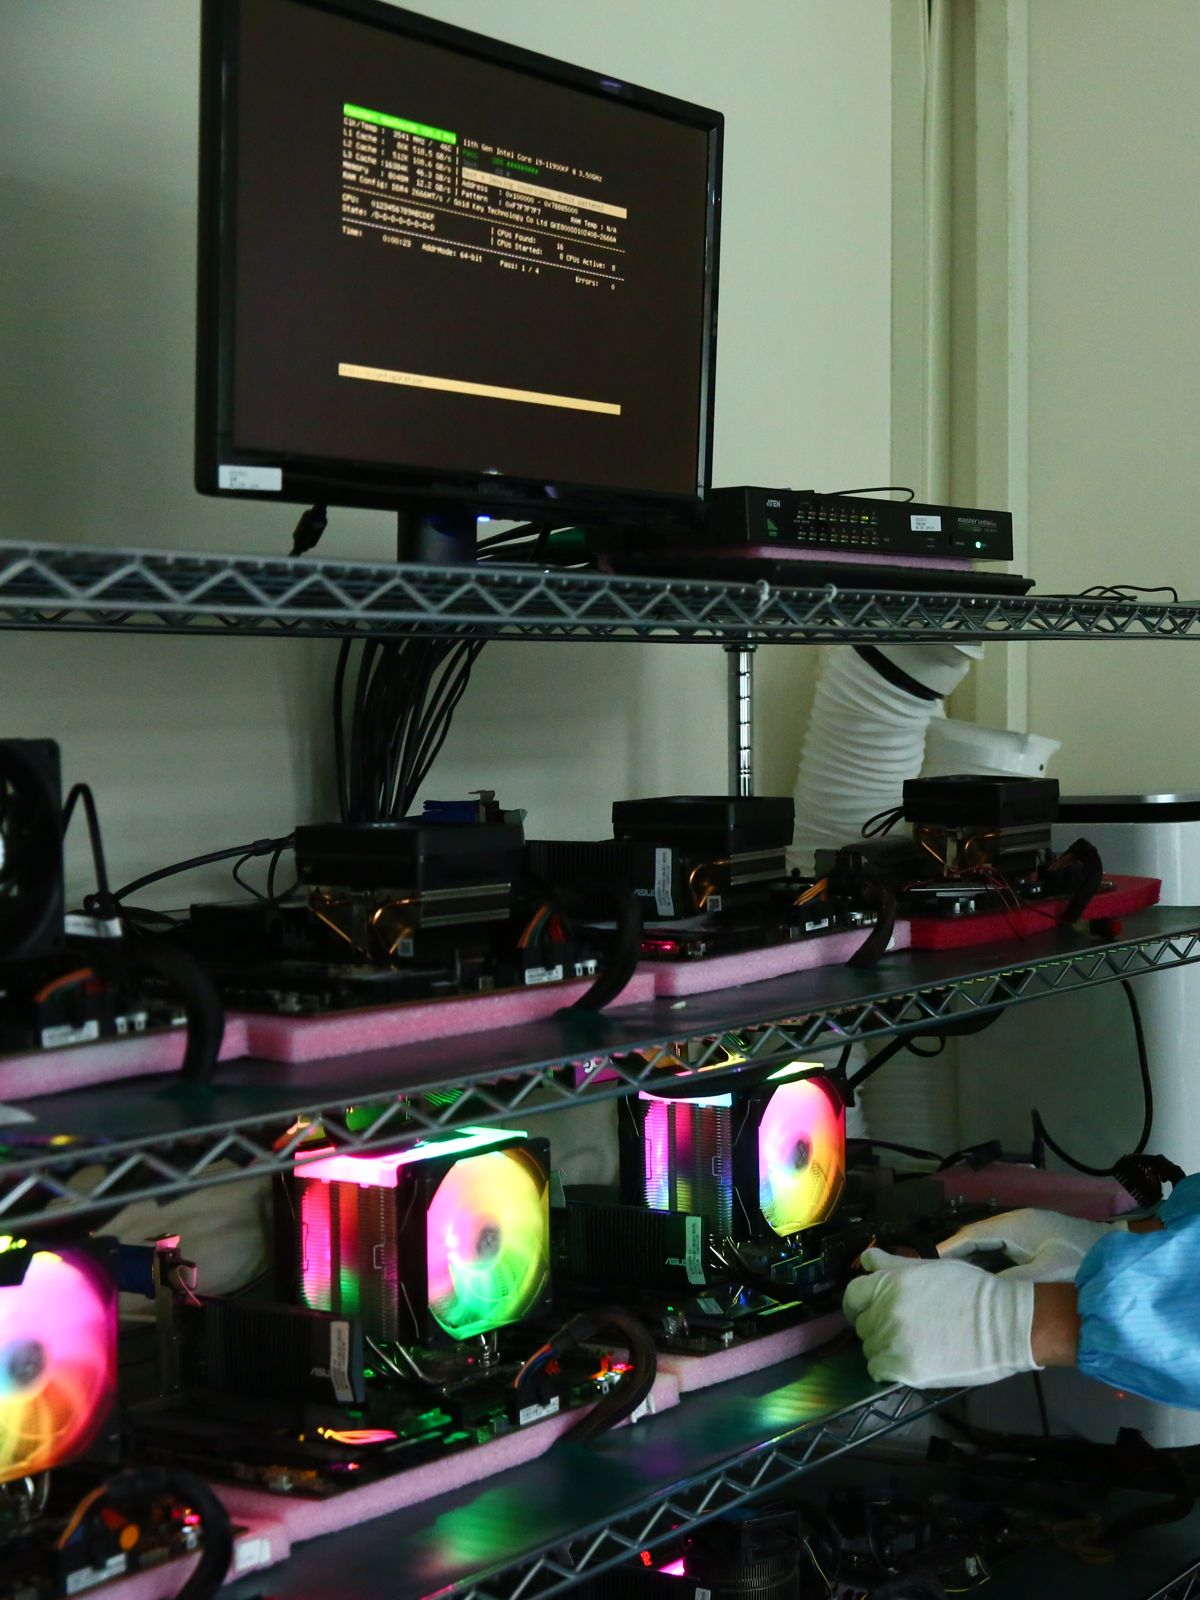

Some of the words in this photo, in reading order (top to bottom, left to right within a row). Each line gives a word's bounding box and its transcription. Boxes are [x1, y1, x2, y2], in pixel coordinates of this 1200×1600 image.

[496, 147, 514, 159] Intel
[487, 205, 523, 222] Technology
[766, 499, 781, 508] ATEN
[634, 888, 655, 897] ASU
